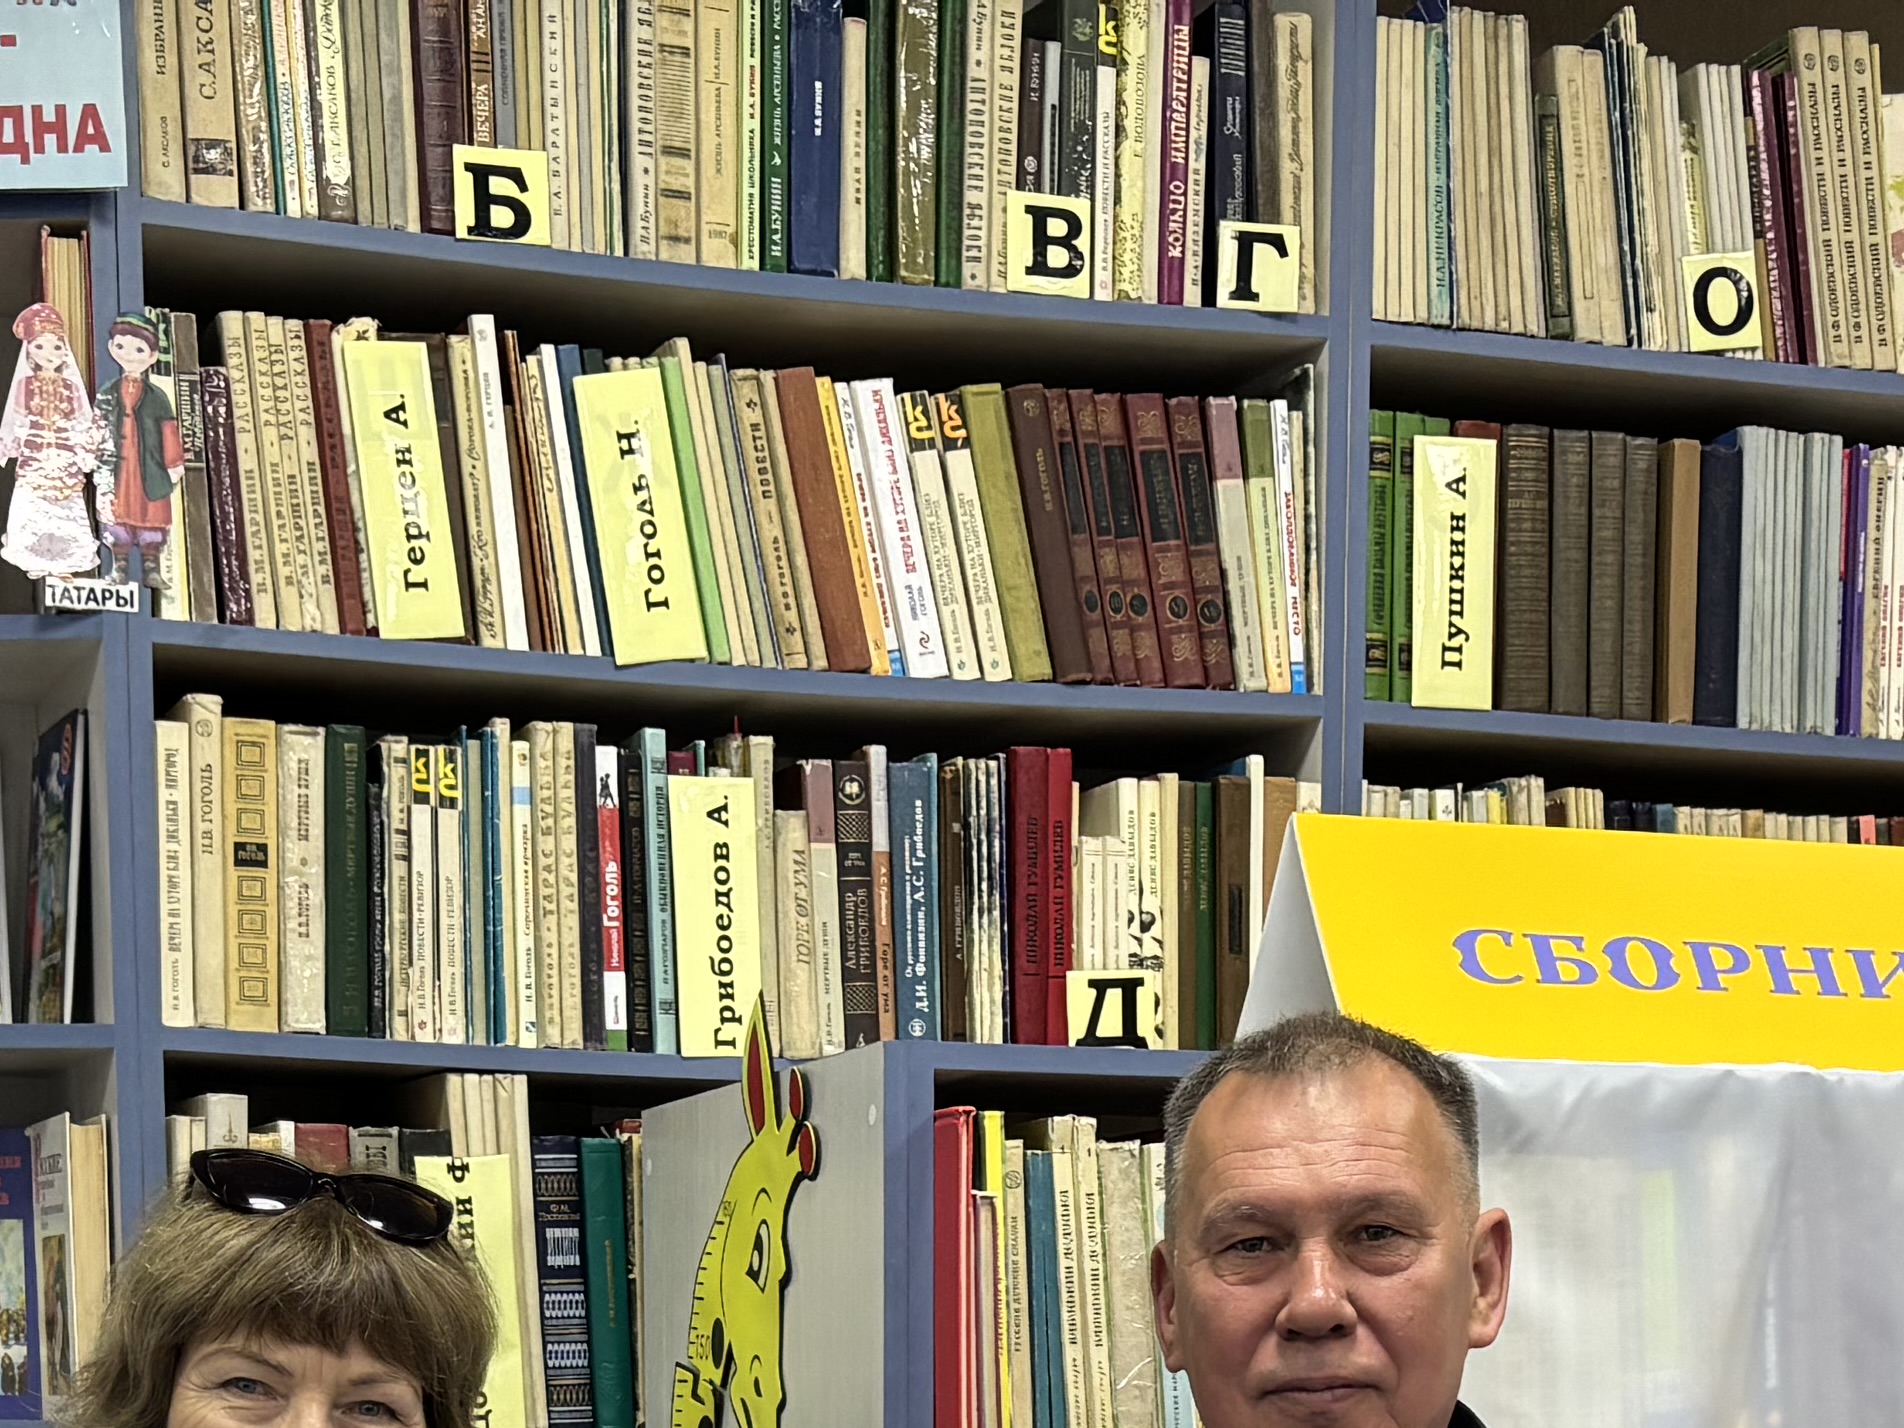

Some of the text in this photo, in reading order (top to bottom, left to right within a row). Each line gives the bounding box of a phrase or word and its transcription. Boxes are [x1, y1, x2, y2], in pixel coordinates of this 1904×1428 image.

[463, 162, 532, 239] Б
[1024, 205, 1085, 279] В
[1228, 231, 1289, 302] Г
[1693, 267, 1753, 336] О
[384, 393, 431, 592] Герцен А.
[616, 420, 669, 613] Гоголь Н.
[47, 584, 135, 609] ТАТАРЫ
[1441, 512, 1469, 671] Пушкин
[706, 795, 744, 1050] Грибоедов А.
[1075, 977, 1149, 1048] Д
